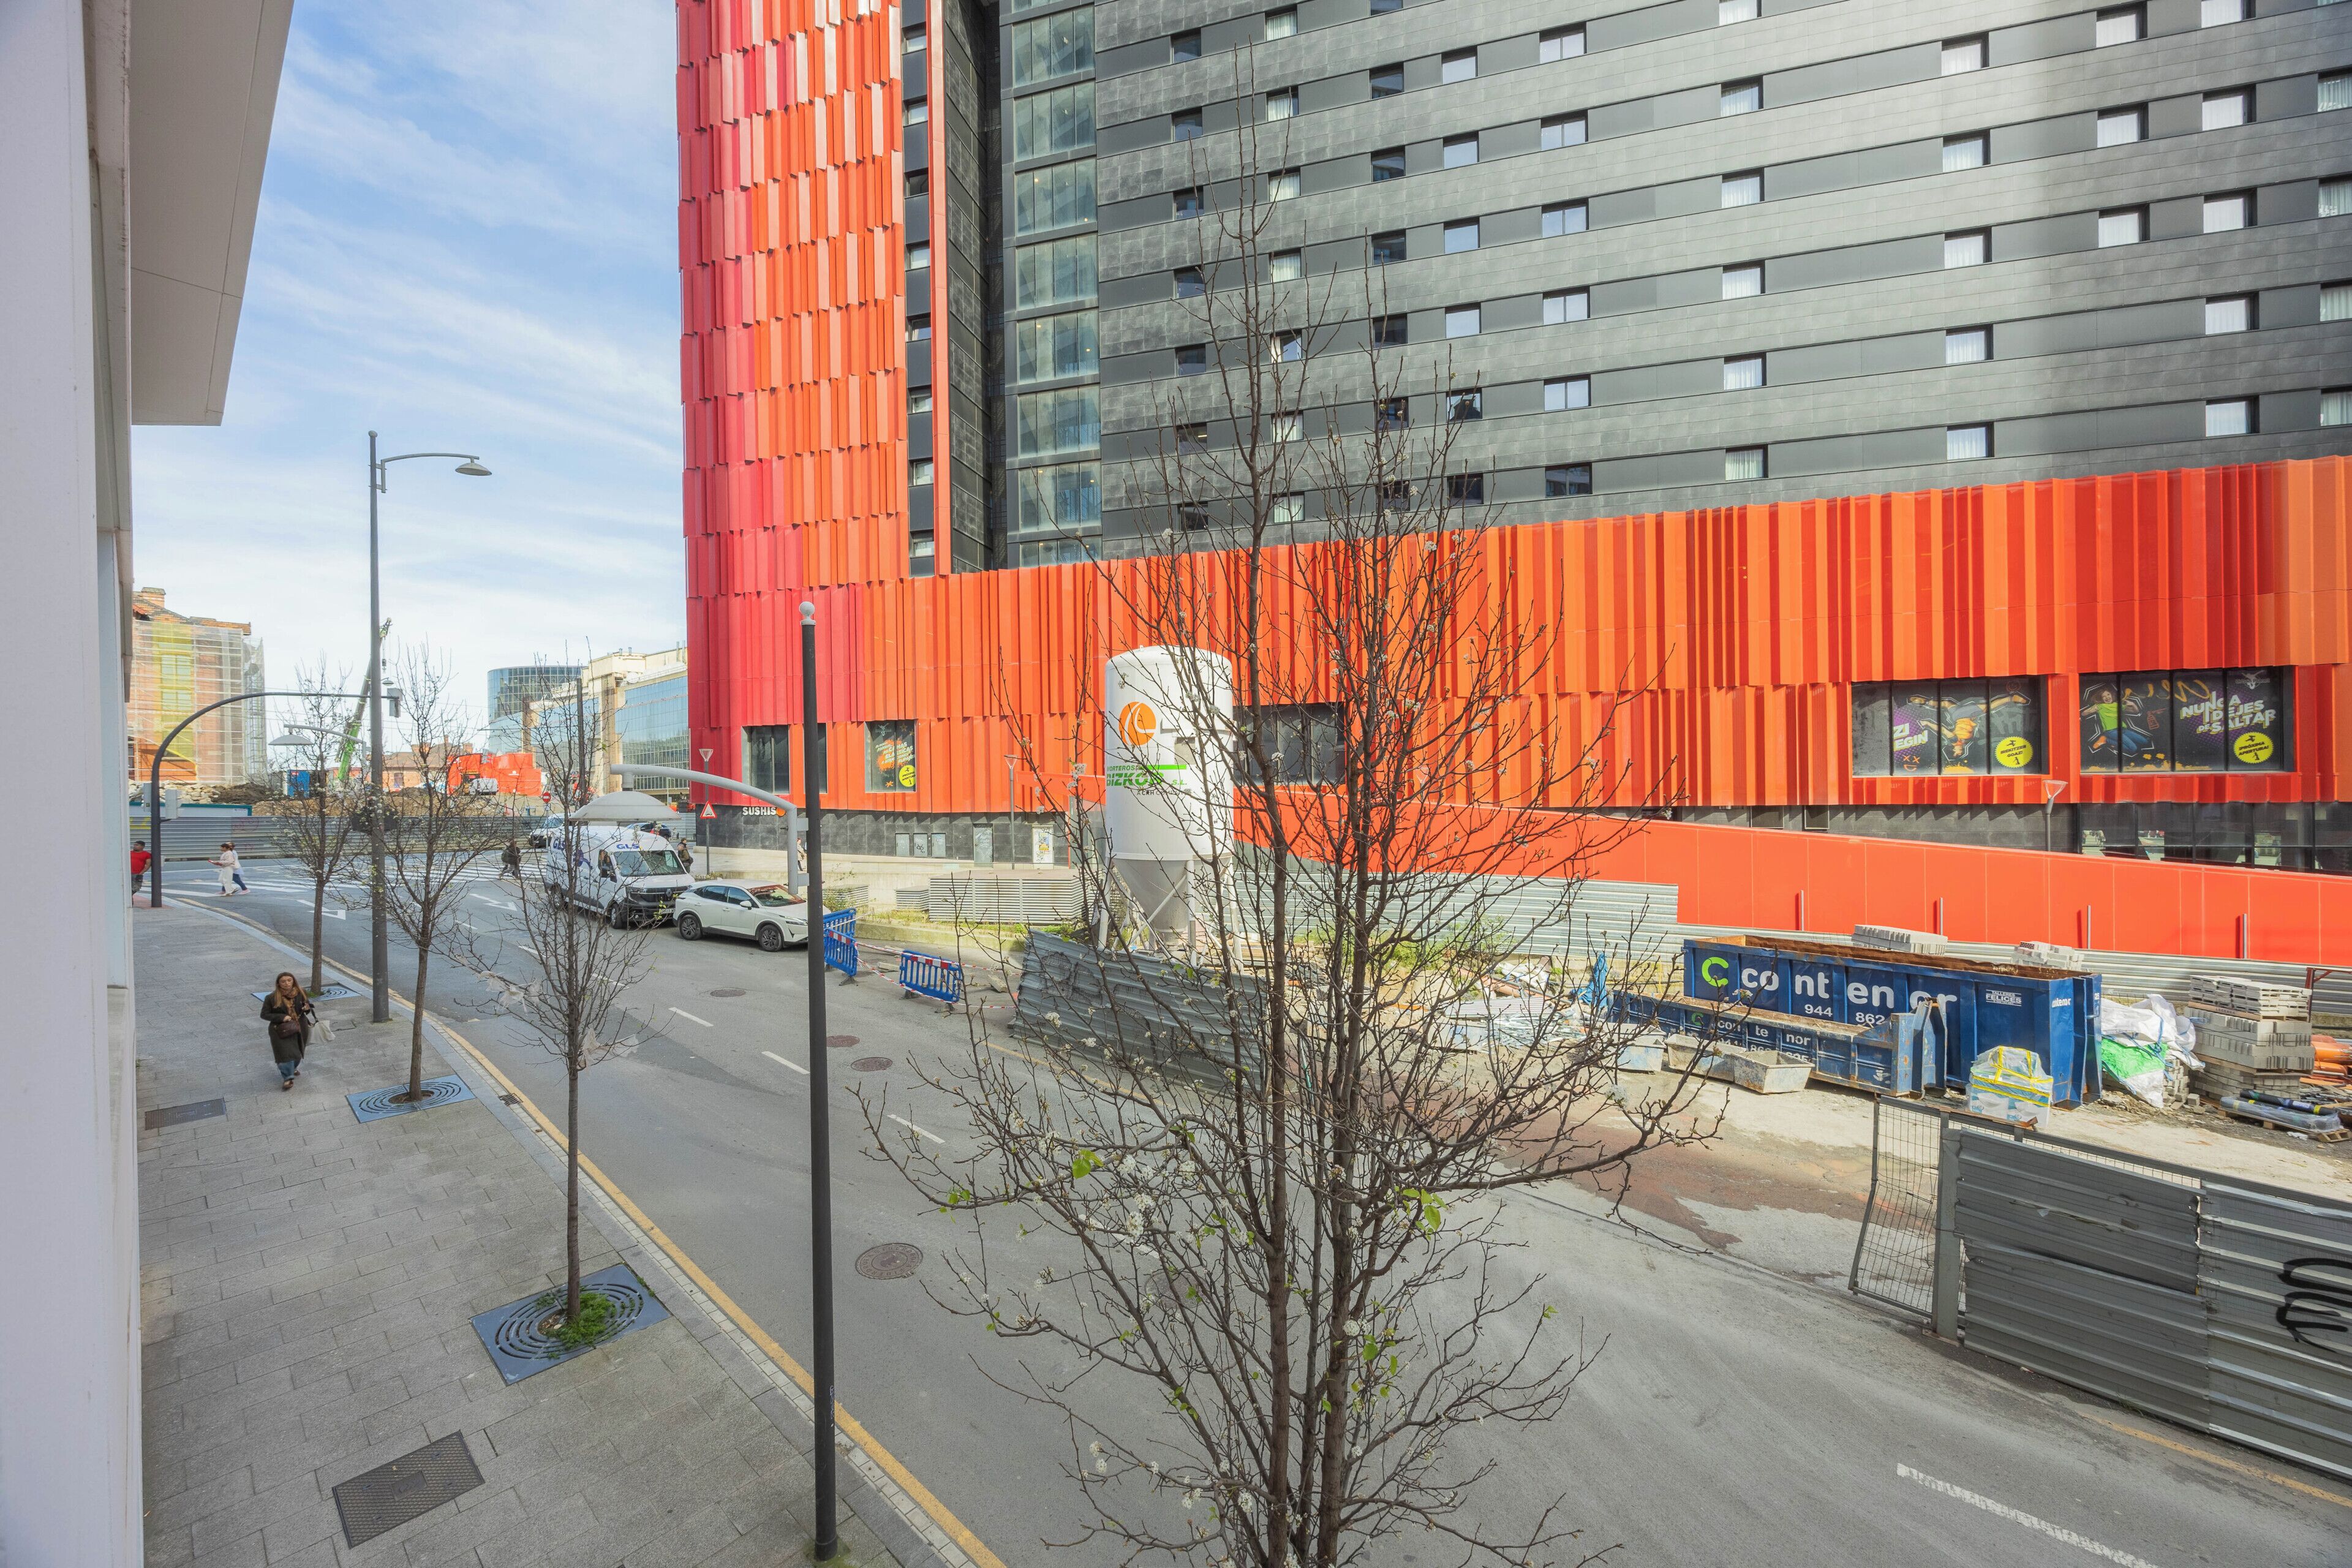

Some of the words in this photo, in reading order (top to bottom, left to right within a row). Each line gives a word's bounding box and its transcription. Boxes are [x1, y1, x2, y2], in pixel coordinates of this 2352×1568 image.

[2212, 700, 2264, 721] DEJES
[2198, 723, 2210, 733] DE
[2211, 709, 2277, 734] SALTAR
[1986, 994, 2022, 1003] FELICES
[1804, 1004, 1832, 1017] 944
[1855, 1012, 1885, 1025] 862
